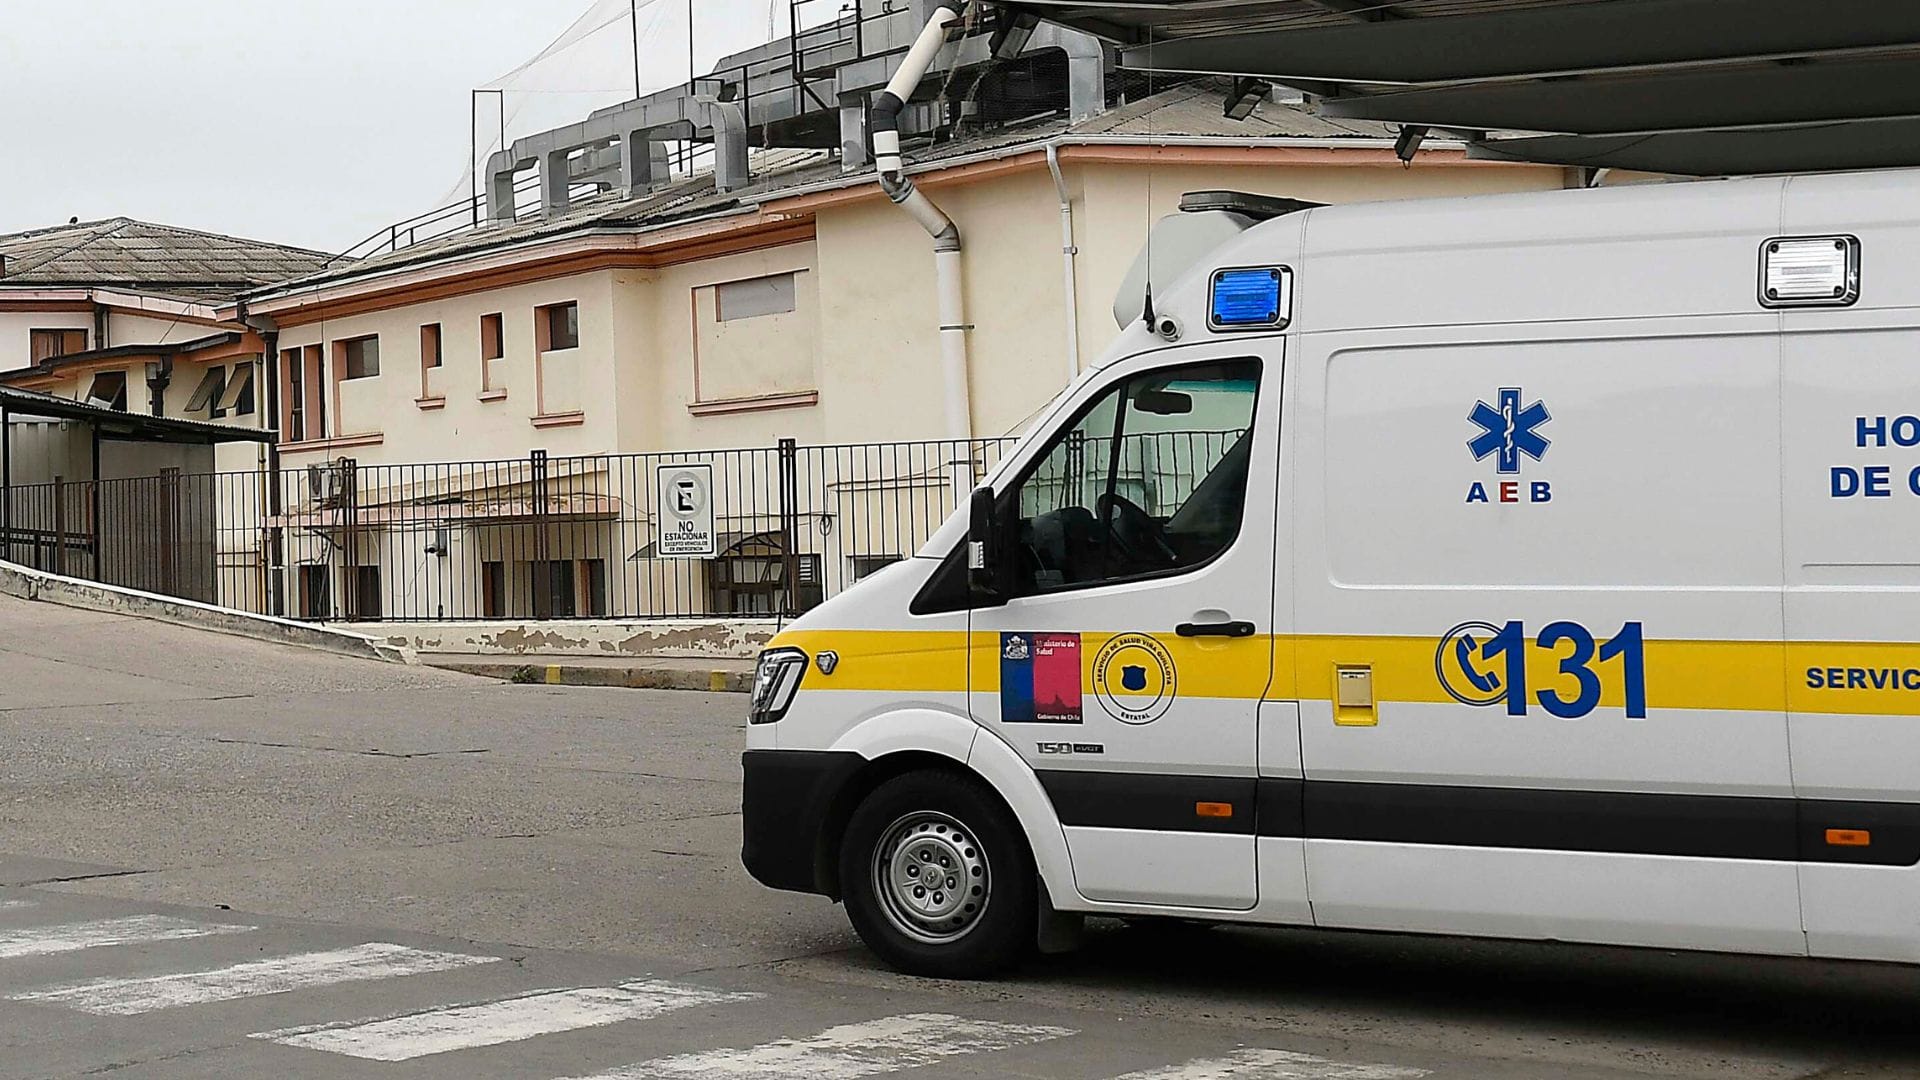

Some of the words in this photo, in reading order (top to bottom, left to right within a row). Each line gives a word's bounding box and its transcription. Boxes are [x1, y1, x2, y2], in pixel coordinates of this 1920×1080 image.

[1830, 466, 1891, 497] DE
[679, 521, 694, 532] NO
[664, 532, 708, 541] ESTACIONAR
[1036, 639, 1067, 648] Mnisterio
[1036, 647, 1053, 656] Salud
[1097, 651, 1110, 683] SERVICIO
[1109, 643, 1119, 651] DE
[1482, 620, 1647, 719] 131
[1806, 667, 1920, 690] SERVIC
[1121, 711, 1151, 720] ESTATAL
[1036, 742, 1072, 754] 150
